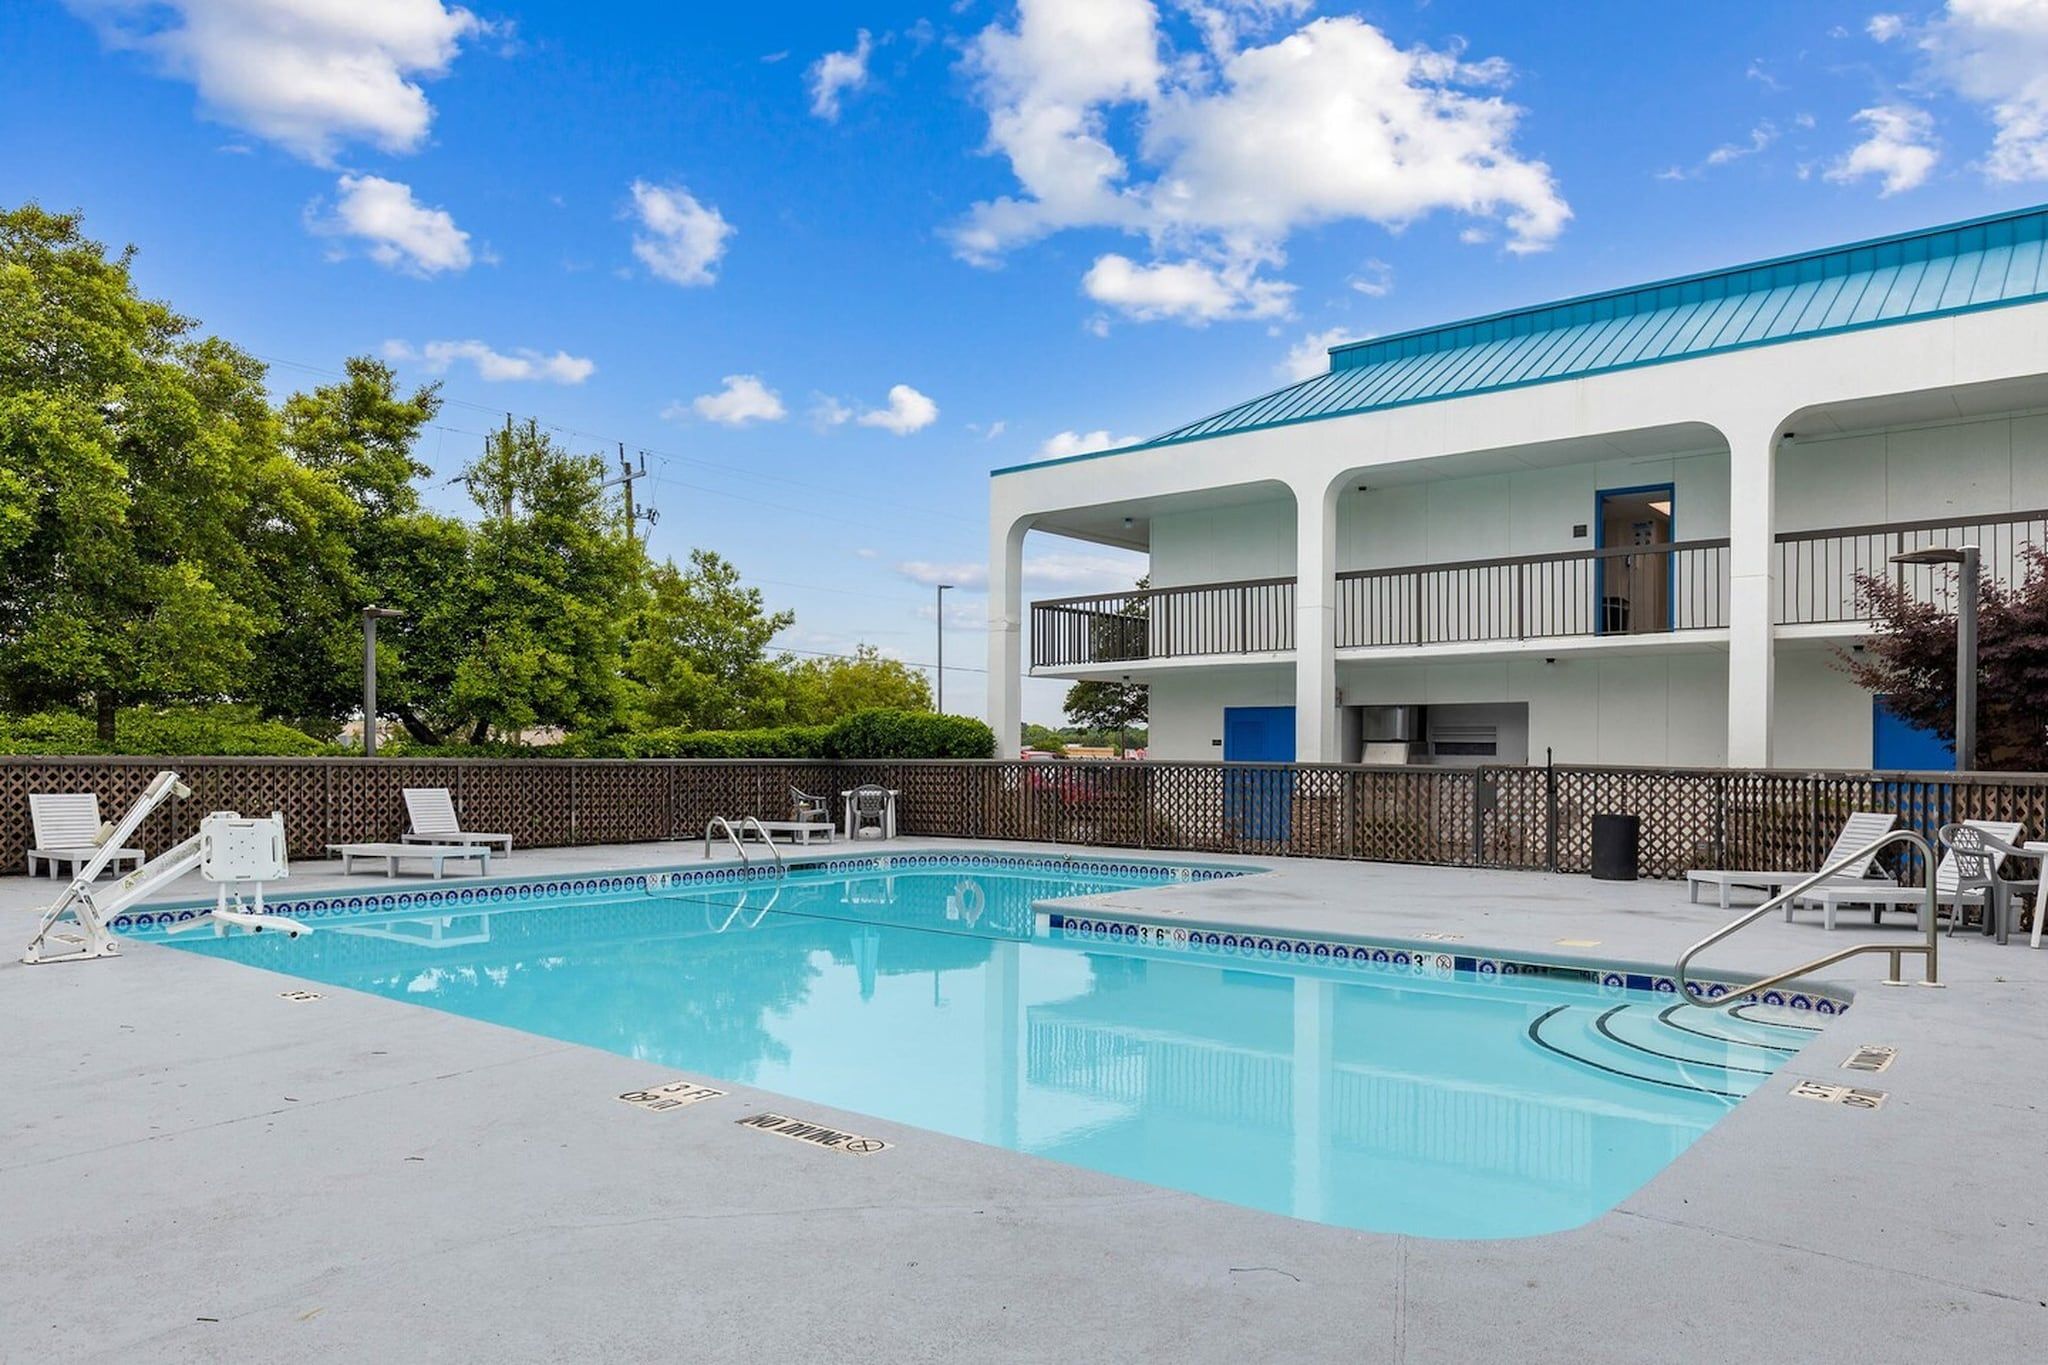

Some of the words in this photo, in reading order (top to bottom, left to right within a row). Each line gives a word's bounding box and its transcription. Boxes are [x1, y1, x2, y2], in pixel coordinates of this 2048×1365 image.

[683, 1089, 722, 1100] FT
[751, 1113, 787, 1128] NO
[774, 1123, 853, 1146] DIVING
